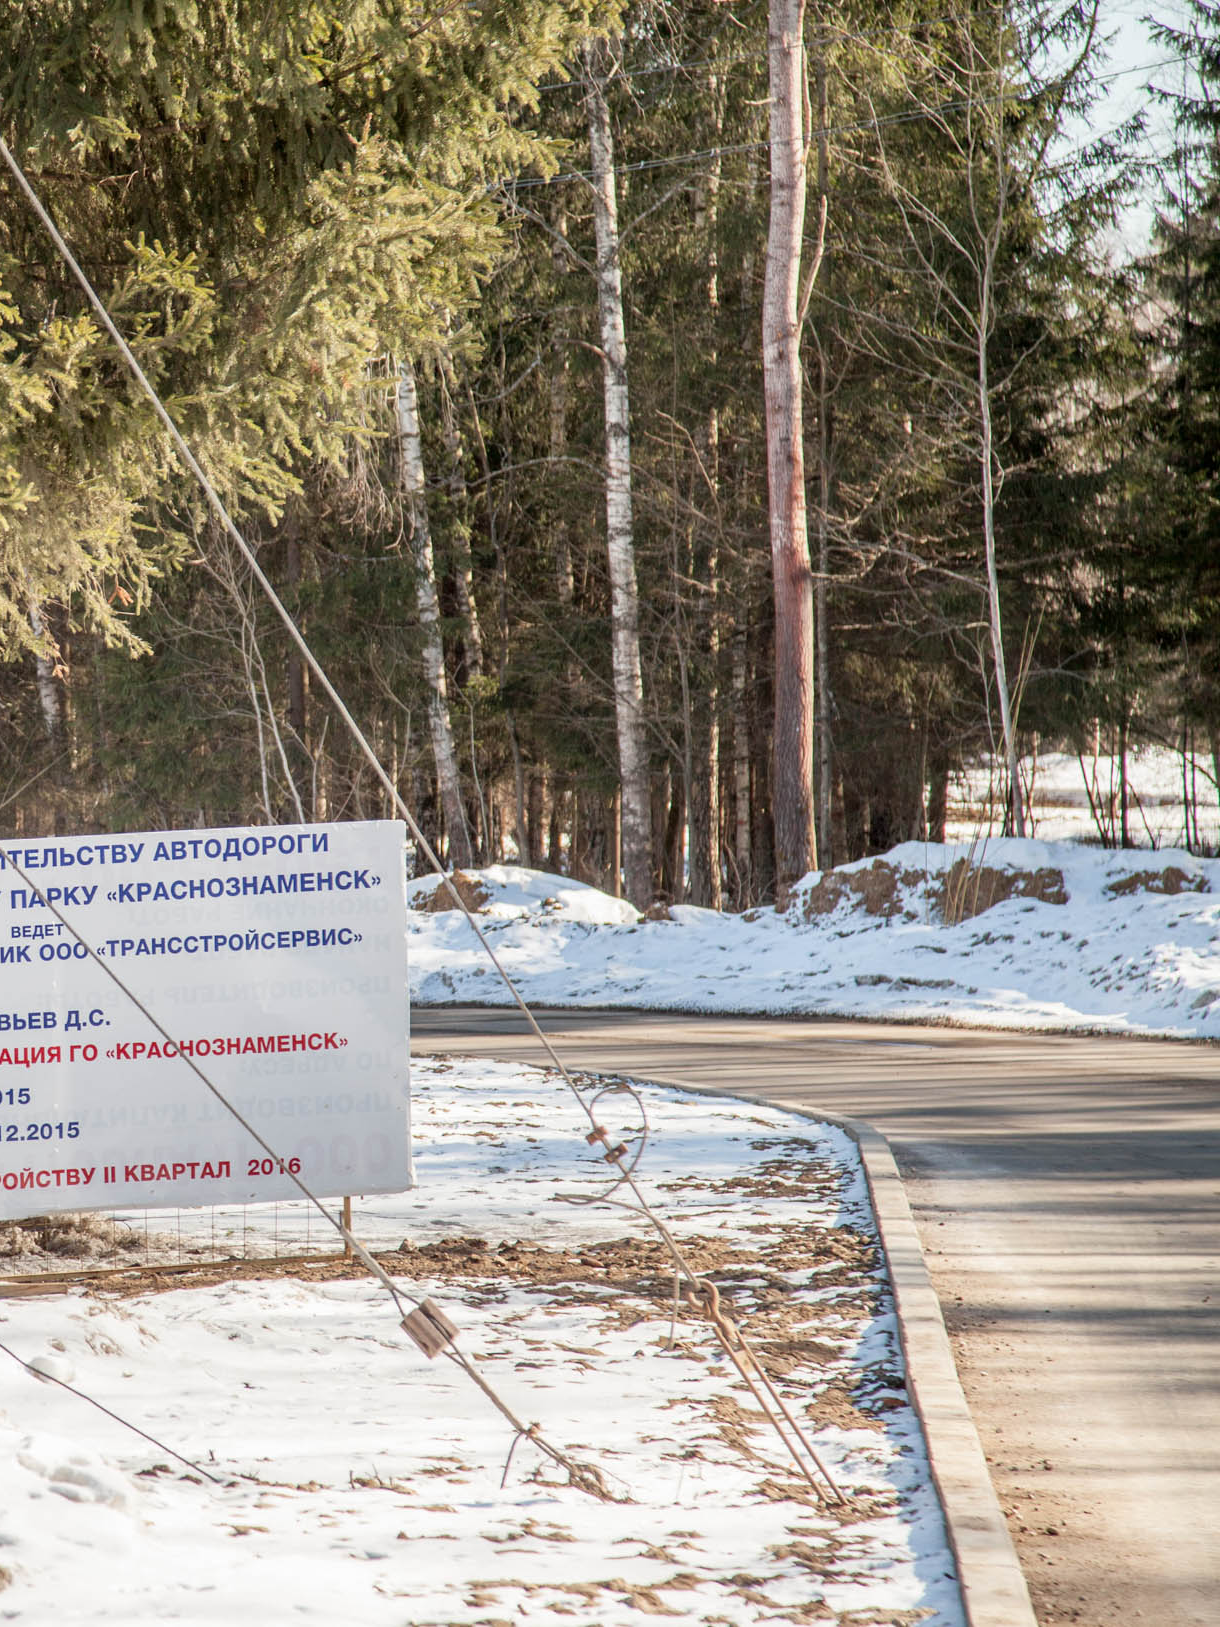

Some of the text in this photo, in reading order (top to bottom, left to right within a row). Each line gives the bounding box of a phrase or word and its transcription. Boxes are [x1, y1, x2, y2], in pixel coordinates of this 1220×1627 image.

[152, 832, 329, 863] АВТОДОРОГИ
[10, 885, 98, 910] ПАРКУ
[107, 869, 381, 904] «КРАСНОЗНАМЕНСК»
[11, 923, 63, 940] ВЕДЕТ
[39, 942, 88, 962] ООО
[96, 927, 362, 957] «ТРАНССТРОЙСЕРВИС»
[64, 1008, 110, 1032] Д.С.
[69, 1043, 99, 1062] ГО
[105, 1031, 348, 1060] «КРАСНОЗНАМЕНСК»
[124, 1161, 231, 1182] КВАРТАЛ
[248, 1157, 301, 1177] 2016
